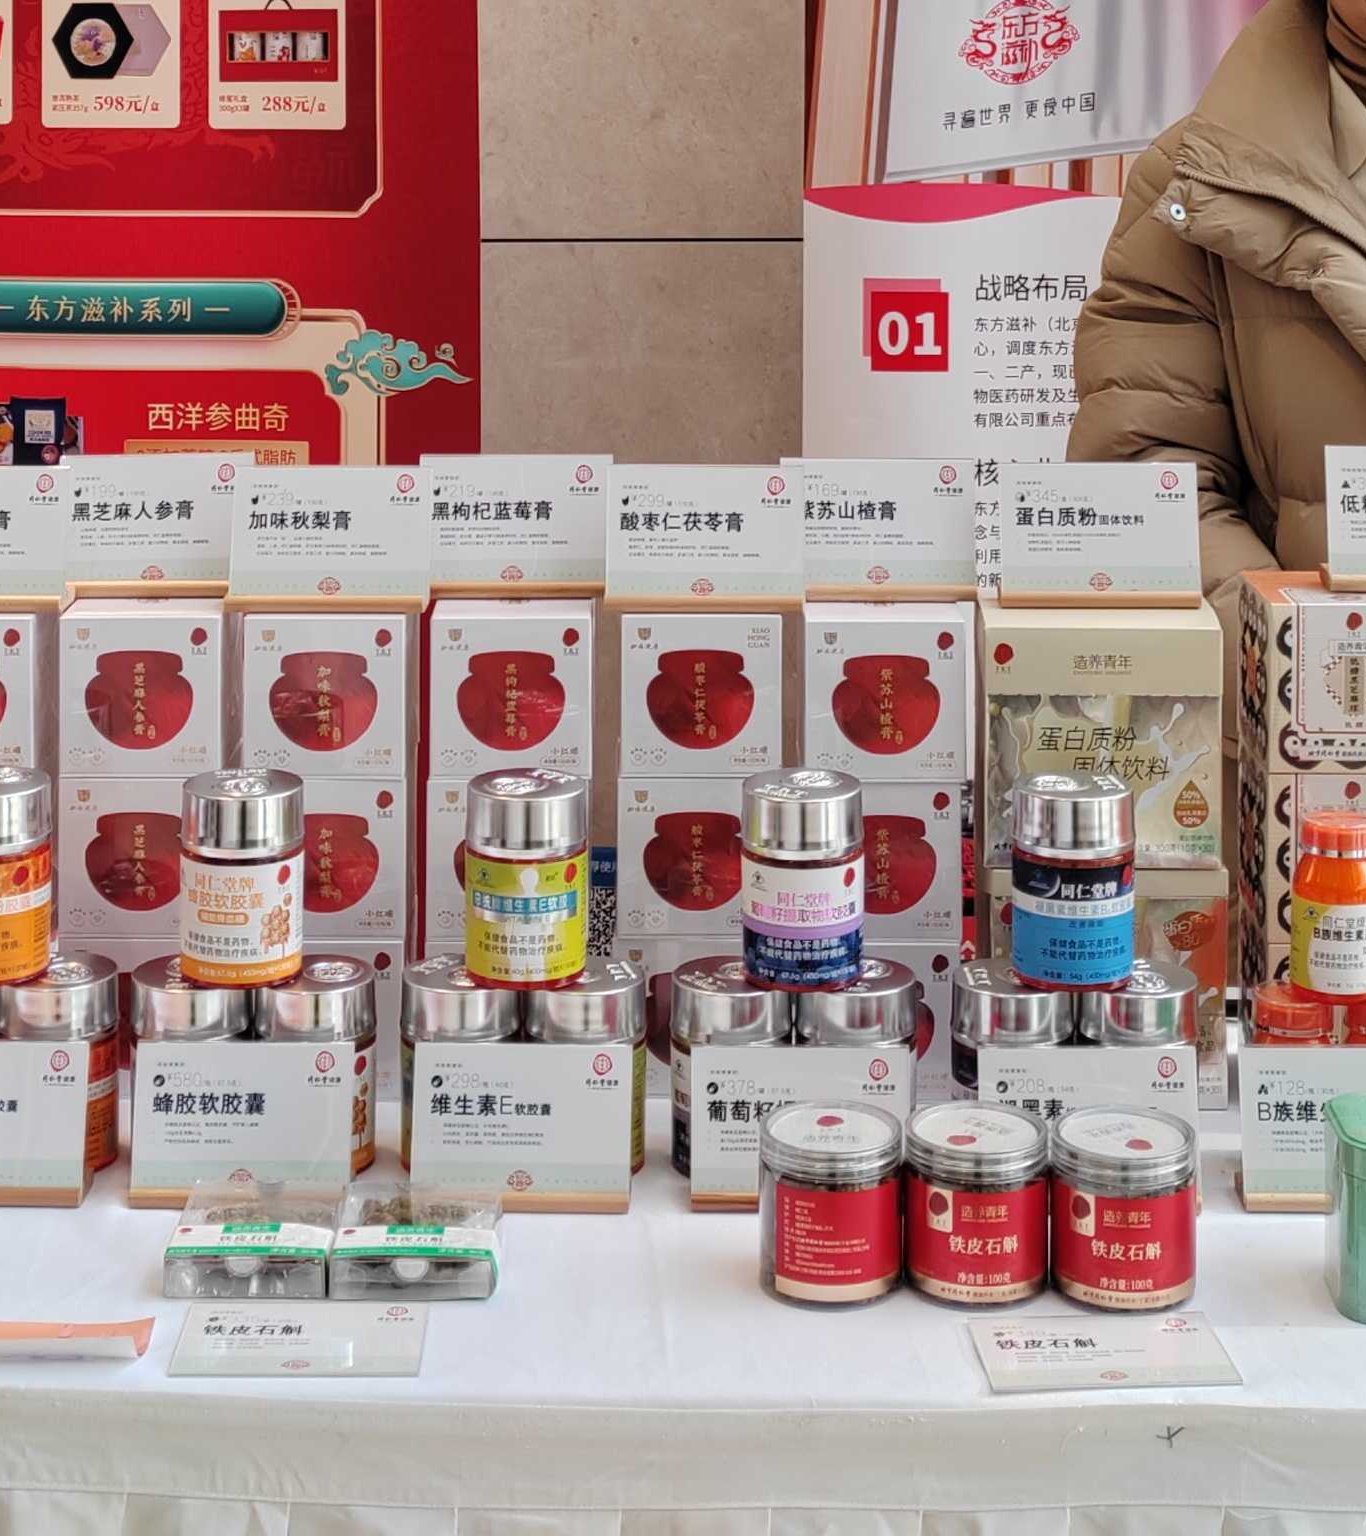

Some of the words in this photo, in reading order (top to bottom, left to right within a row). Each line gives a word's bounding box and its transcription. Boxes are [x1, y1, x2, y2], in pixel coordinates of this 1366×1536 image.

[975, 273, 1088, 304] 战略布局
[26, 295, 194, 323] 东方滋补系列
[877, 311, 942, 357] 01
[147, 402, 290, 432] 西洋参曲奇
[70, 500, 195, 522] 黑芝麻人参膏
[248, 510, 352, 531] 加味秋梨膏
[431, 500, 554, 522] 黑枸杞蓝莓膏
[619, 511, 745, 533] 酸枣仁茯苓膏
[1036, 726, 1137, 753] 蛋白质粉
[1060, 881, 1118, 900] 同仁堂牌
[152, 1091, 267, 1116] 蜂胶软胶囊
[948, 1234, 1019, 1256] 铁皮石斛
[1090, 1238, 1163, 1262] 铁皮石斛
[203, 1323, 303, 1337] 铁皮石斛
